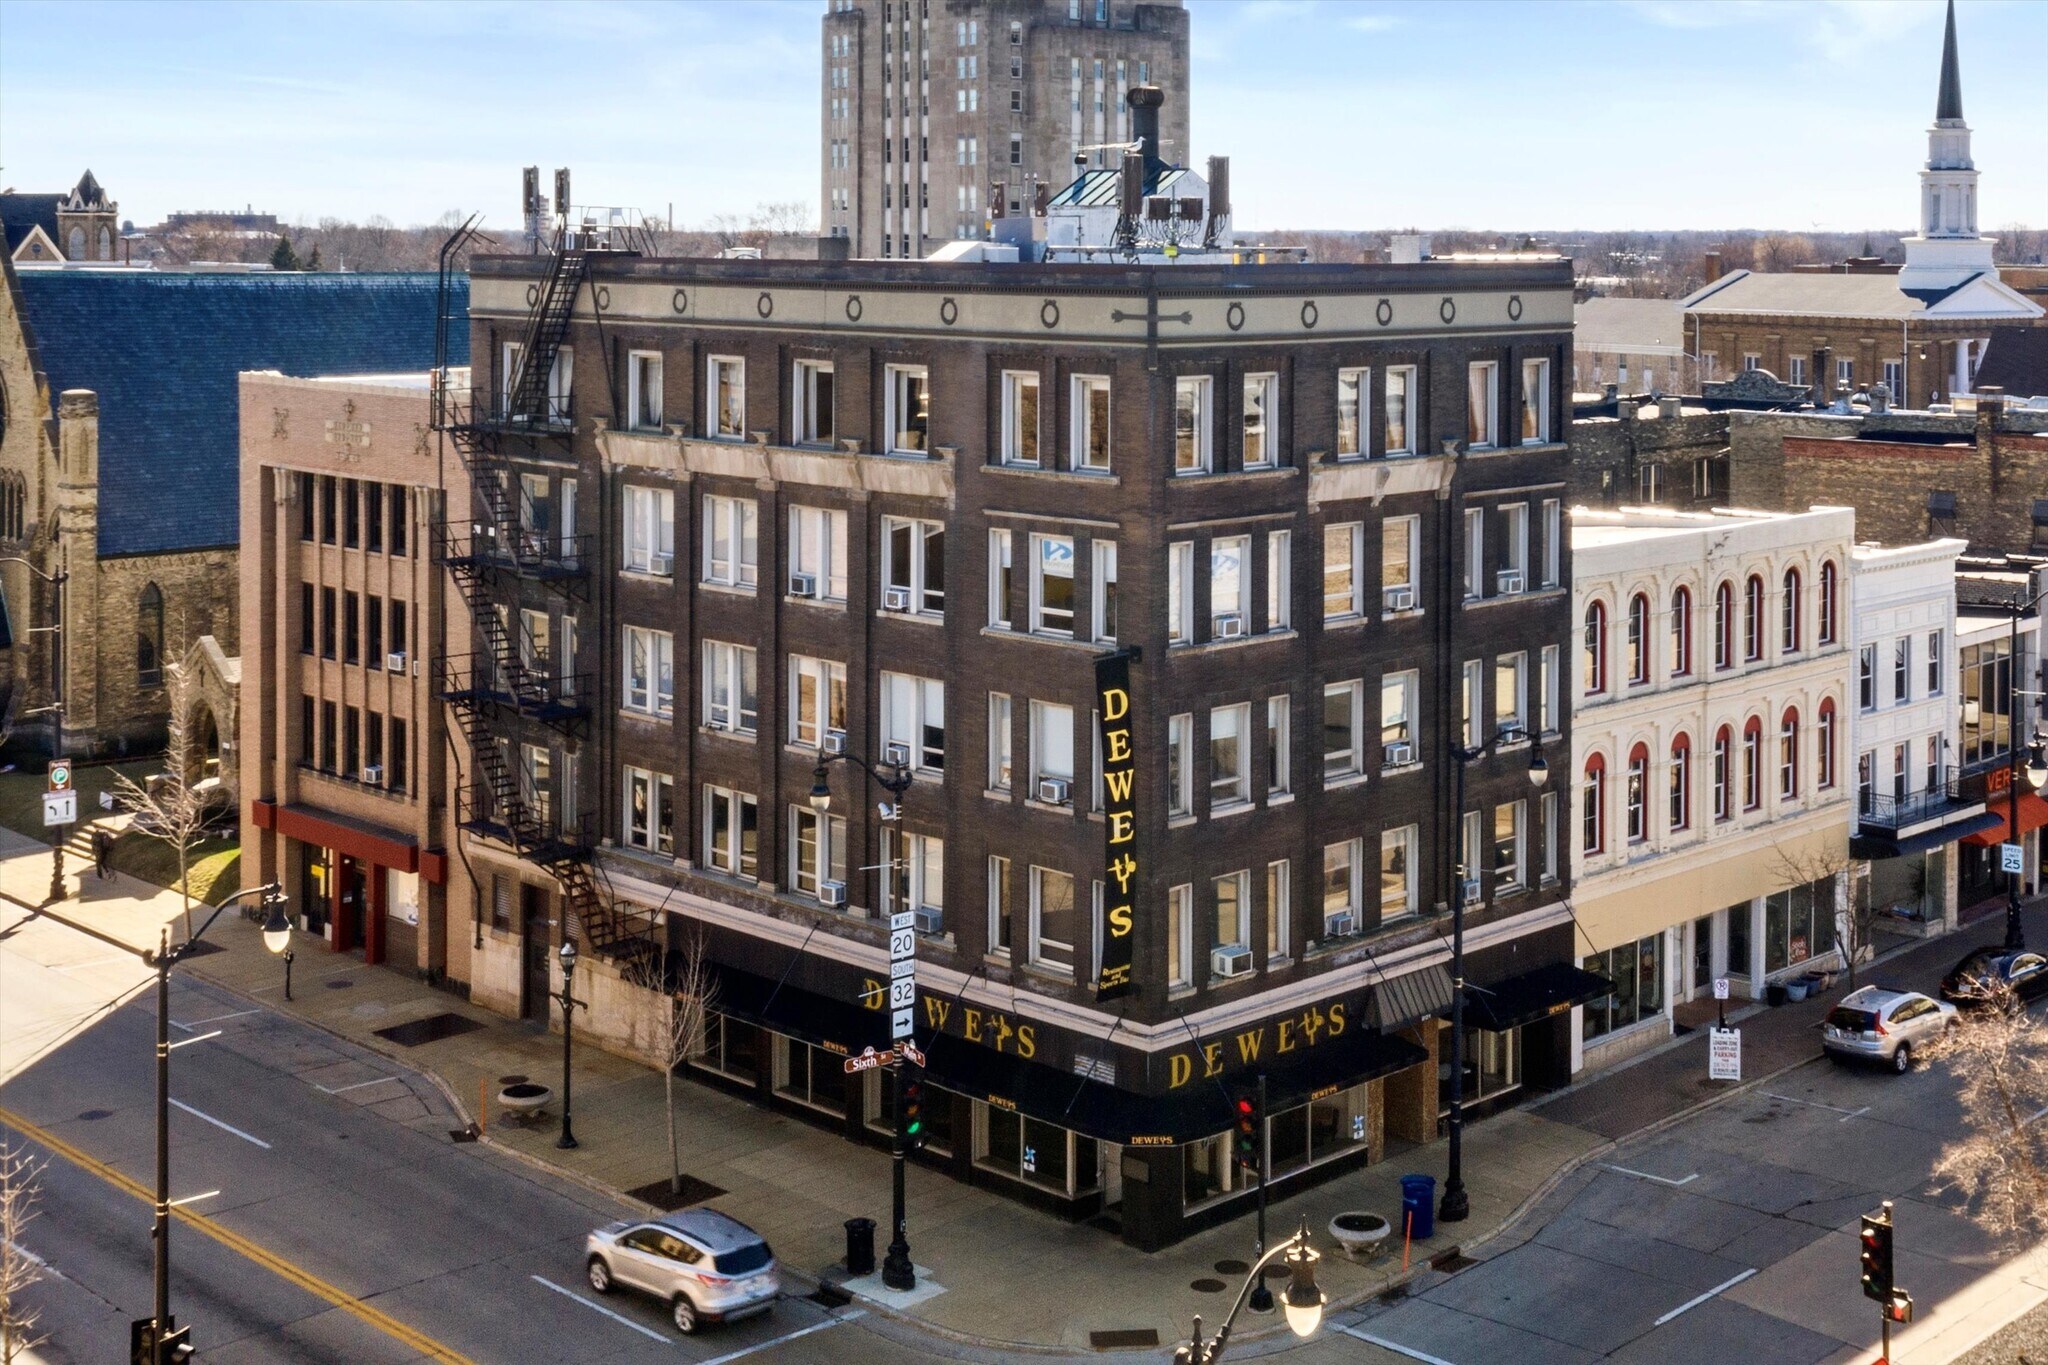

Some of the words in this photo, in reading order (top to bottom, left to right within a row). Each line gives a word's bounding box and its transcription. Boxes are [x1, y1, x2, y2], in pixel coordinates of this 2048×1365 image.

[2003, 846, 2021, 854] SPEED
[2004, 858, 2021, 870] 25
[894, 914, 912, 927] WEST
[893, 934, 913, 954] 20
[892, 962, 913, 977] SOUTH
[894, 982, 913, 1002] 32
[852, 1055, 878, 1071] Sixth
